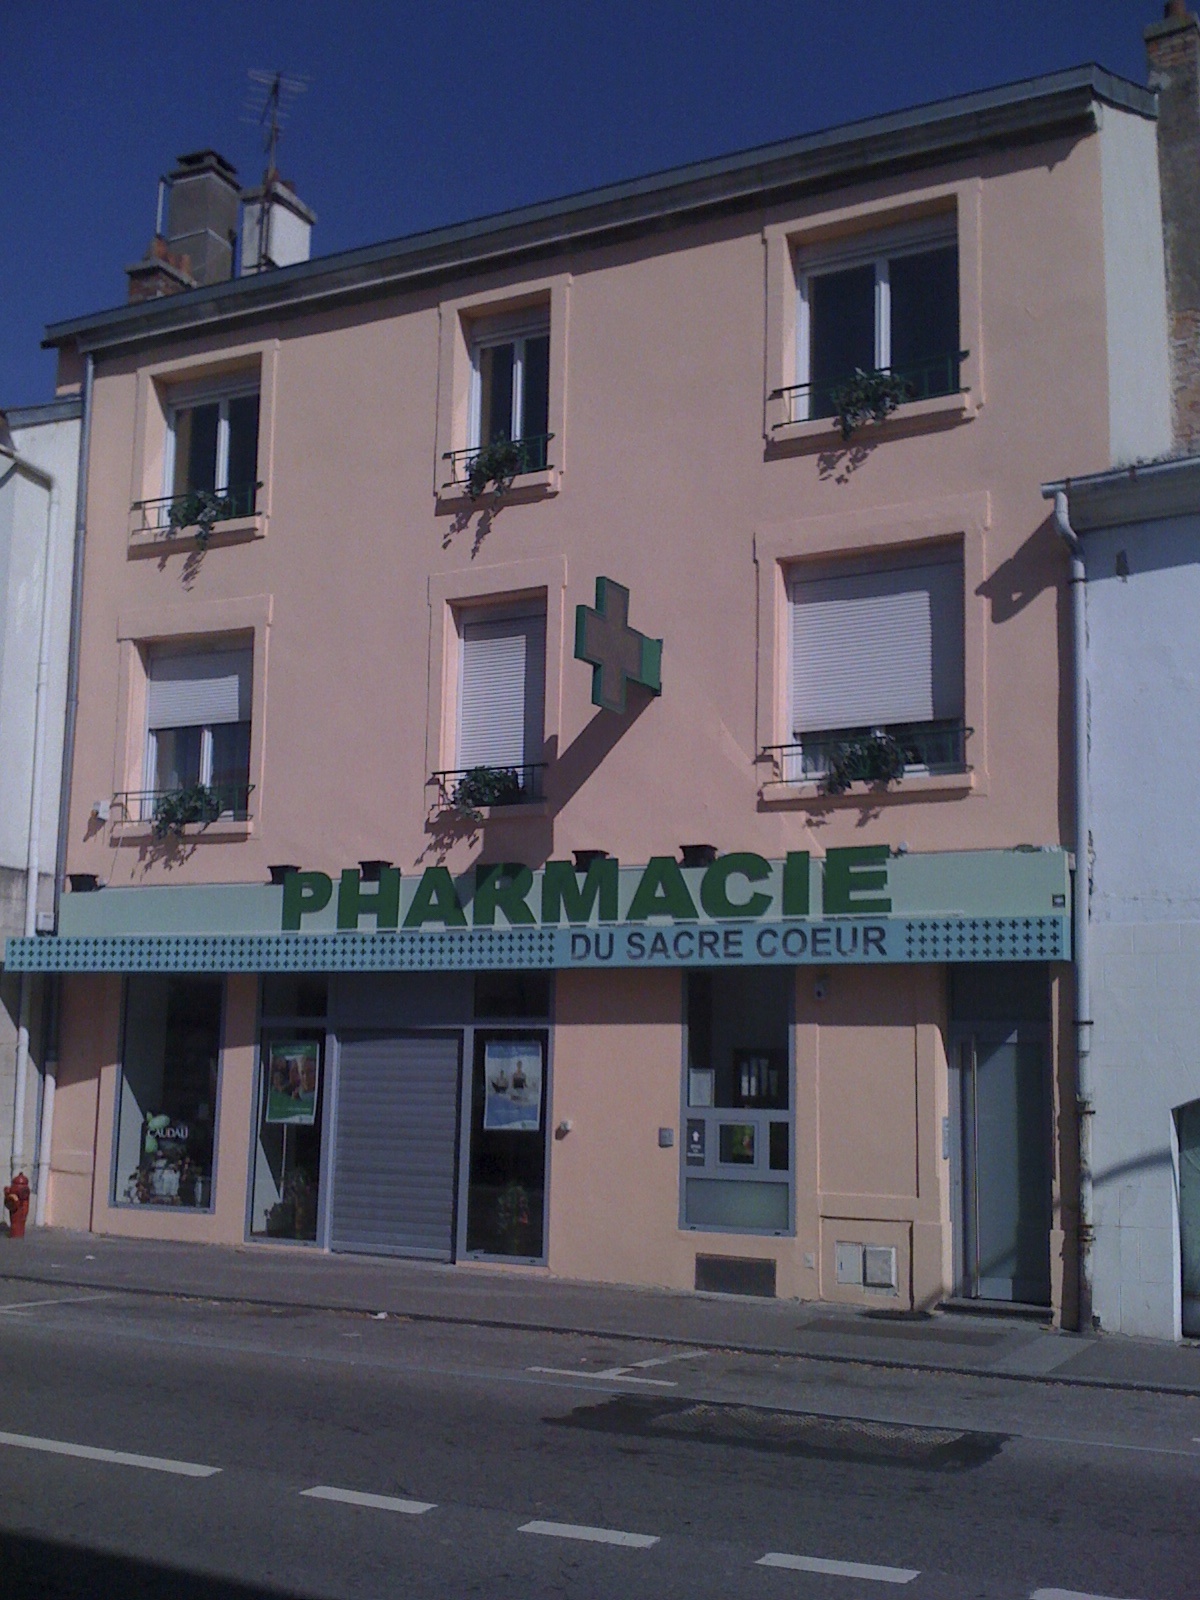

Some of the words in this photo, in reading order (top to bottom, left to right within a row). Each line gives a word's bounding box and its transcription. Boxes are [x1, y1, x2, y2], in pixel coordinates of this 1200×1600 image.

[281, 844, 892, 930] PHARMACIE
[571, 932, 614, 961] DU
[626, 930, 744, 960] SACRE
[756, 926, 887, 957] COEUR
